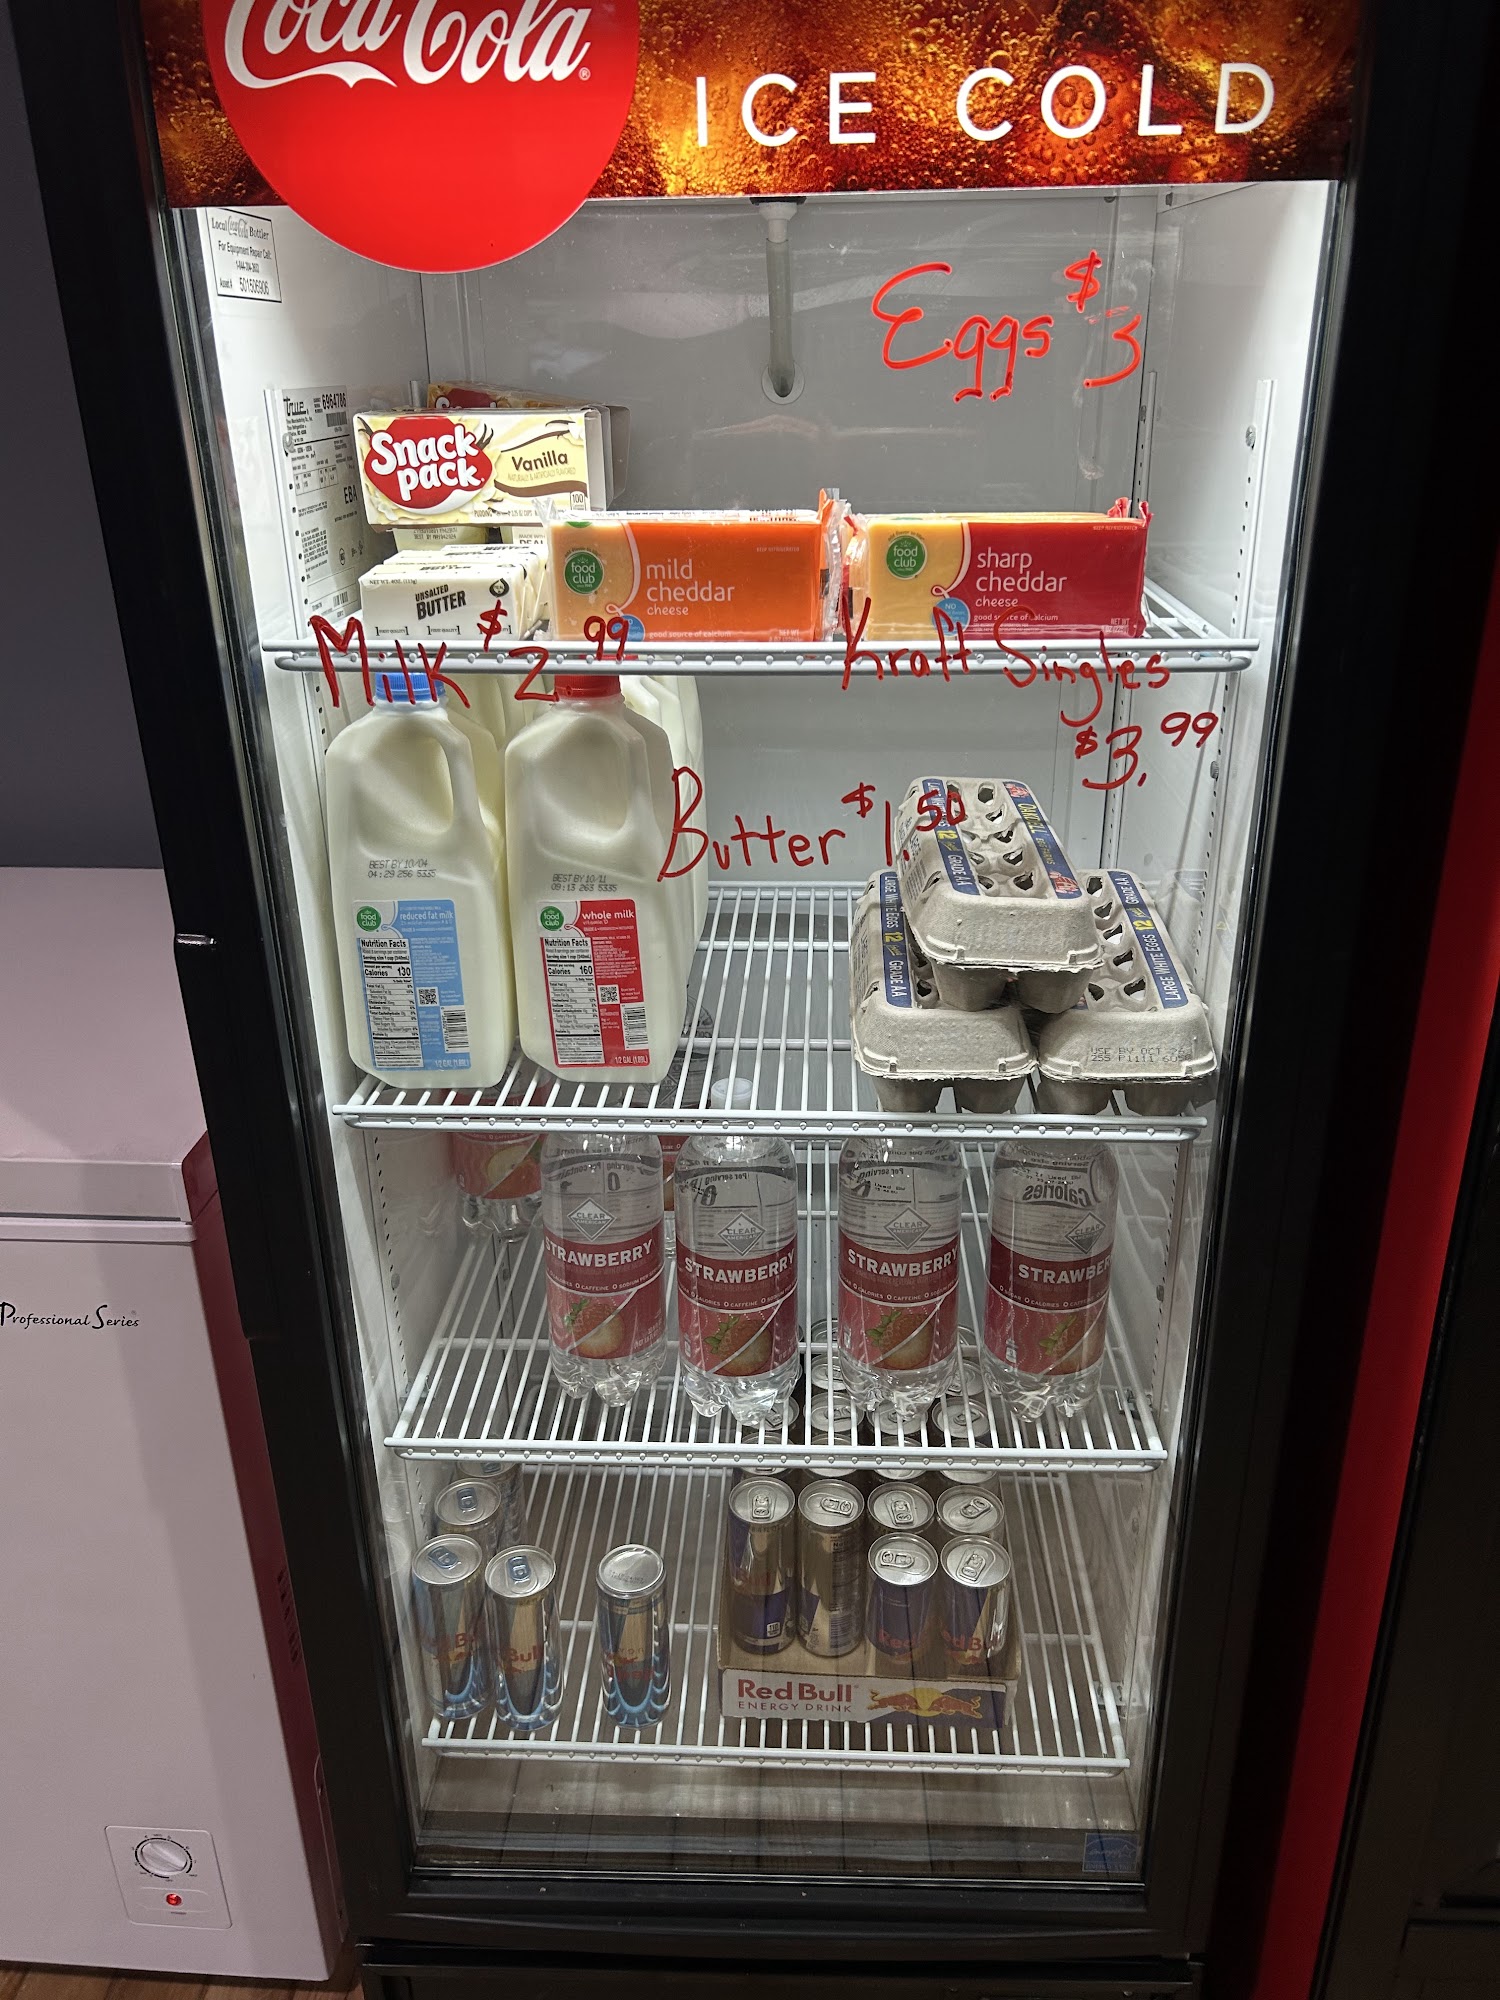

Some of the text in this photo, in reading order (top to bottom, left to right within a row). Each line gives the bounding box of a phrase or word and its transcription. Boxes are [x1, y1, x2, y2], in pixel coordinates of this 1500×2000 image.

[696, 62, 1275, 147] ICE COLD
[211, 217, 270, 240] Local Bottler
[218, 240, 226, 251] For
[227, 241, 249, 256] Equipment
[249, 247, 262, 260] Repair
[871, 262, 1054, 402] Eggs
[322, 392, 347, 410] 6964786
[371, 425, 479, 475] Snack
[511, 450, 568, 471] Vanilla
[396, 458, 482, 501] pack
[572, 493, 583, 503] 100
[893, 545, 918, 557] food
[893, 556, 917, 568] club
[977, 547, 1033, 574] sharp
[571, 562, 595, 574] food
[646, 559, 693, 580] mild
[573, 573, 595, 584] club
[975, 571, 1067, 592] cheddar
[414, 584, 449, 602] UNSALTED
[646, 581, 735, 602] cheddar
[415, 590, 467, 620] BUTTER
[975, 596, 1019, 607] cheese
[647, 603, 689, 616] cheese
[973, 613, 992, 622] good
[1110, 617, 1121, 625] NET
[649, 631, 666, 640] good
[702, 631, 732, 639] calcium
[841, 594, 1171, 728] Kraft Singles
[656, 766, 846, 882] Butter
[937, 829, 958, 839] 12
[369, 860, 391, 869] BEST
[391, 859, 403, 869] BY
[947, 854, 967, 876] GRADE
[552, 873, 573, 883] BEST
[573, 874, 585, 883] BY
[360, 912, 376, 921] food
[400, 910, 454, 920] reduced fat milk
[543, 912, 560, 920] food
[582, 909, 635, 920] whole milk
[544, 938, 589, 947] Nutrition Facts
[884, 875, 908, 998] LARGE WHITE EGGS 12 GRADE AA
[1114, 874, 1182, 1001] LARGE WHITE EGGS 12 GRADE AA
[361, 939, 407, 948] Nutrition Facts
[364, 965, 411, 977] Calories 130
[548, 965, 593, 975] Calories 160
[1090, 1047, 1111, 1055] USE
[1118, 1047, 1134, 1055] BY
[1140, 1047, 1161, 1055] OCT
[622, 1056, 633, 1064] GAL
[727, 1226, 758, 1235] CLEAR
[893, 1221, 923, 1229] CLEAR
[1074, 1223, 1101, 1235] CLEAR
[545, 1236, 653, 1267] STRAWBERRY
[684, 1248, 795, 1284] STRAWBERRY
[847, 1245, 958, 1277] STRAWBERRY
[581, 1283, 610, 1291] CAFFEINE
[618, 1279, 638, 1289] SODIUM
[857, 1286, 884, 1299] CALORIES
[730, 1300, 758, 1308] CAFFEINE
[1030, 1299, 1060, 1307] CALORIES
[0, 1301, 140, 1330] Professional Series
[737, 1678, 852, 1703] Red Bull
[738, 1701, 852, 1713] ENERGY DRINK
